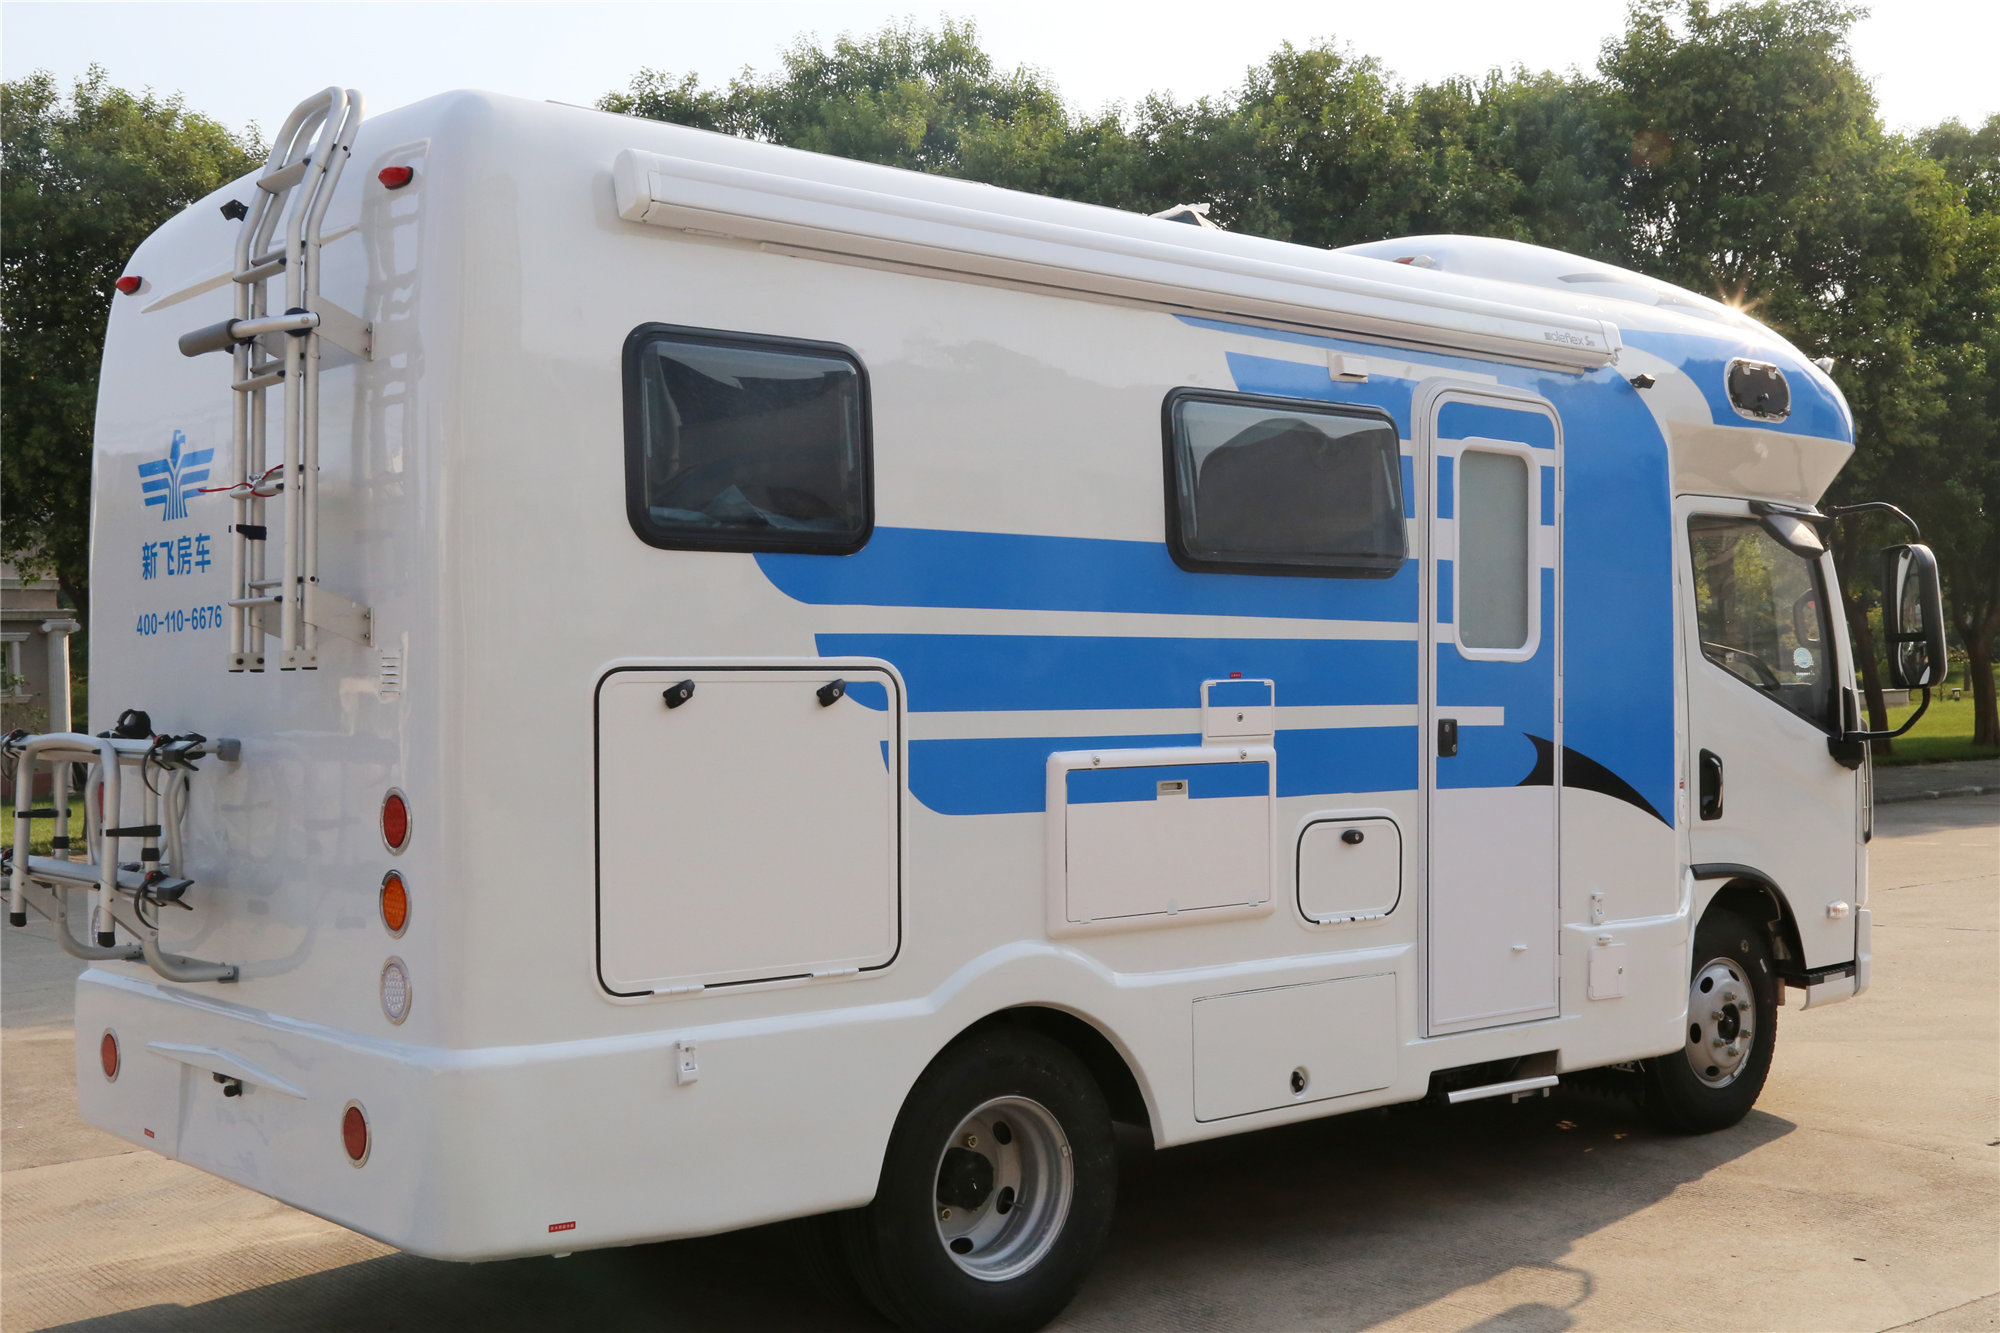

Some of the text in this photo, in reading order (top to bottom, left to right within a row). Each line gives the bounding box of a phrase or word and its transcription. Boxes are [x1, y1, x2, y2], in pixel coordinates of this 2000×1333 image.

[142, 533, 212, 580] 新飞房车
[136, 605, 222, 636] 400-110-6676
